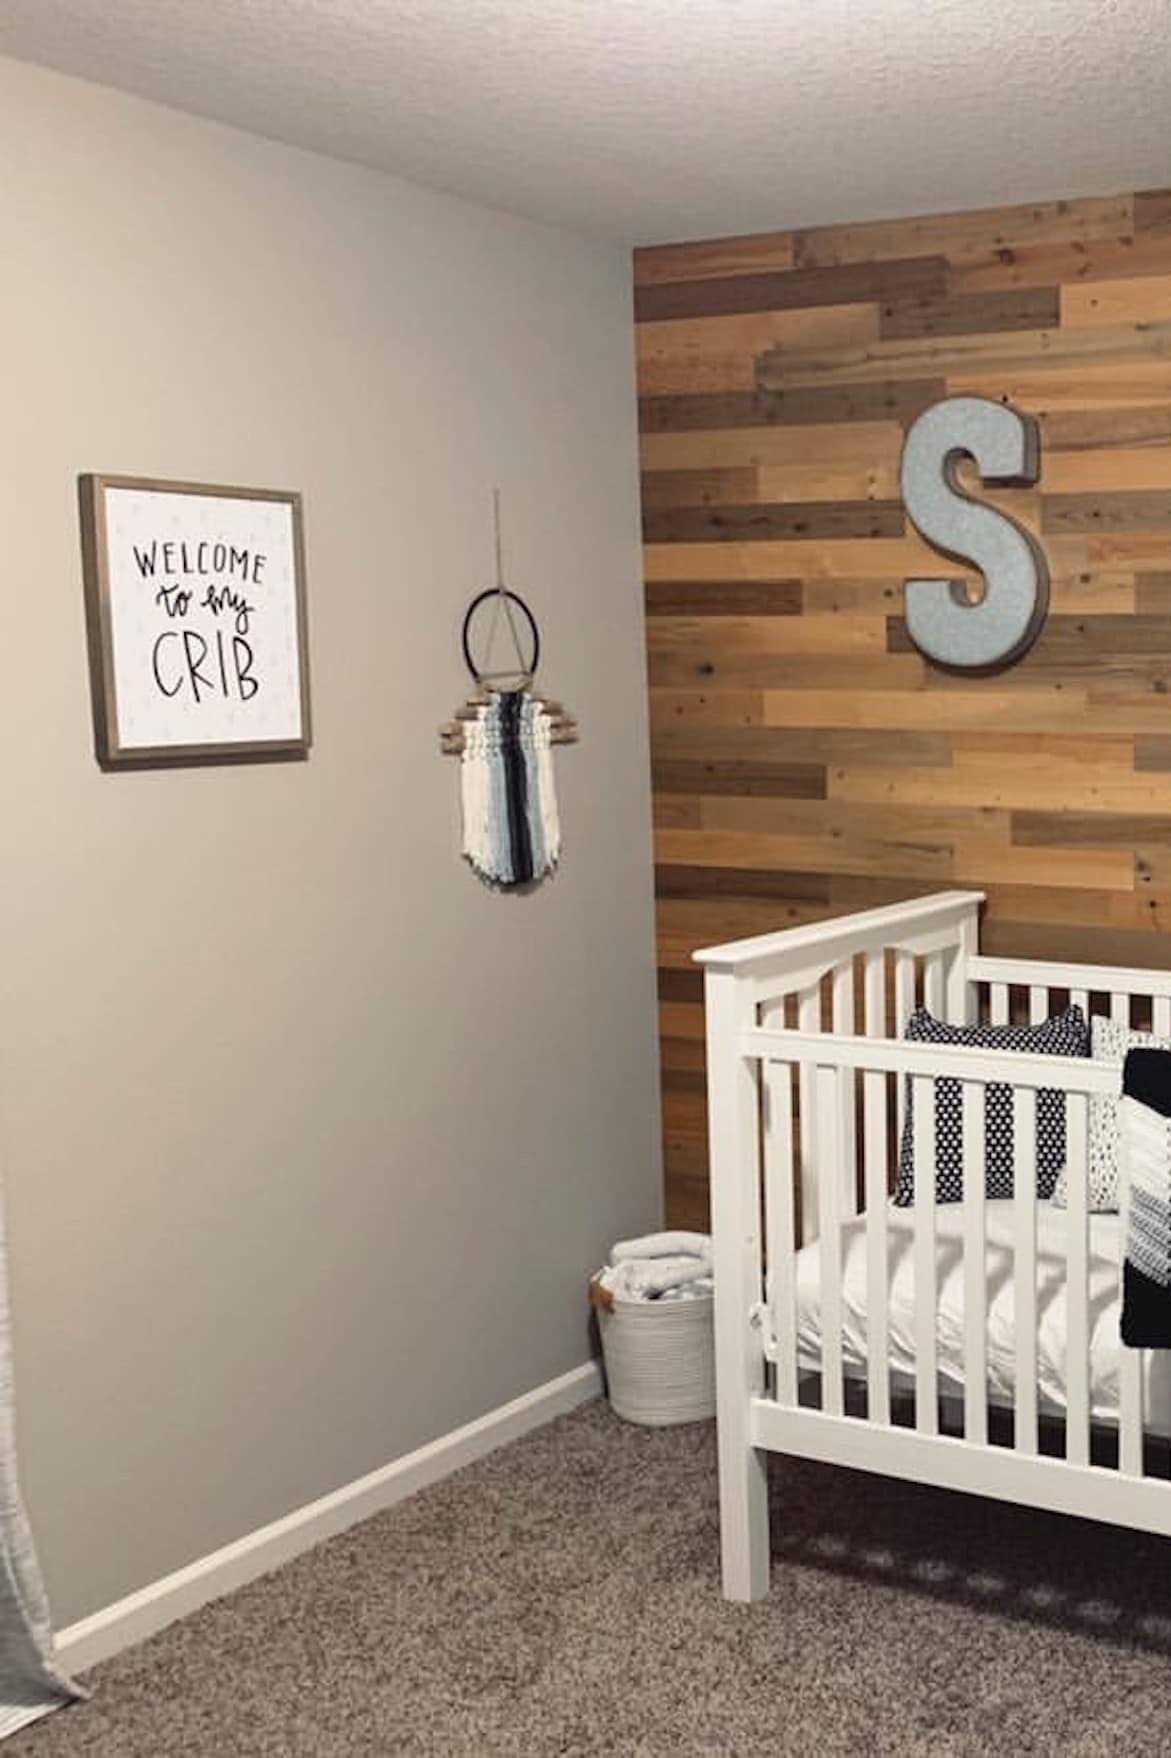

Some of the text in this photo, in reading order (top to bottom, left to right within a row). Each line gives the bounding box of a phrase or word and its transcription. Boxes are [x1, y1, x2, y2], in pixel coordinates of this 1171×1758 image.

[132, 539, 267, 584] WELCOME
[155, 584, 255, 635] to my
[152, 629, 259, 704] CRIB
